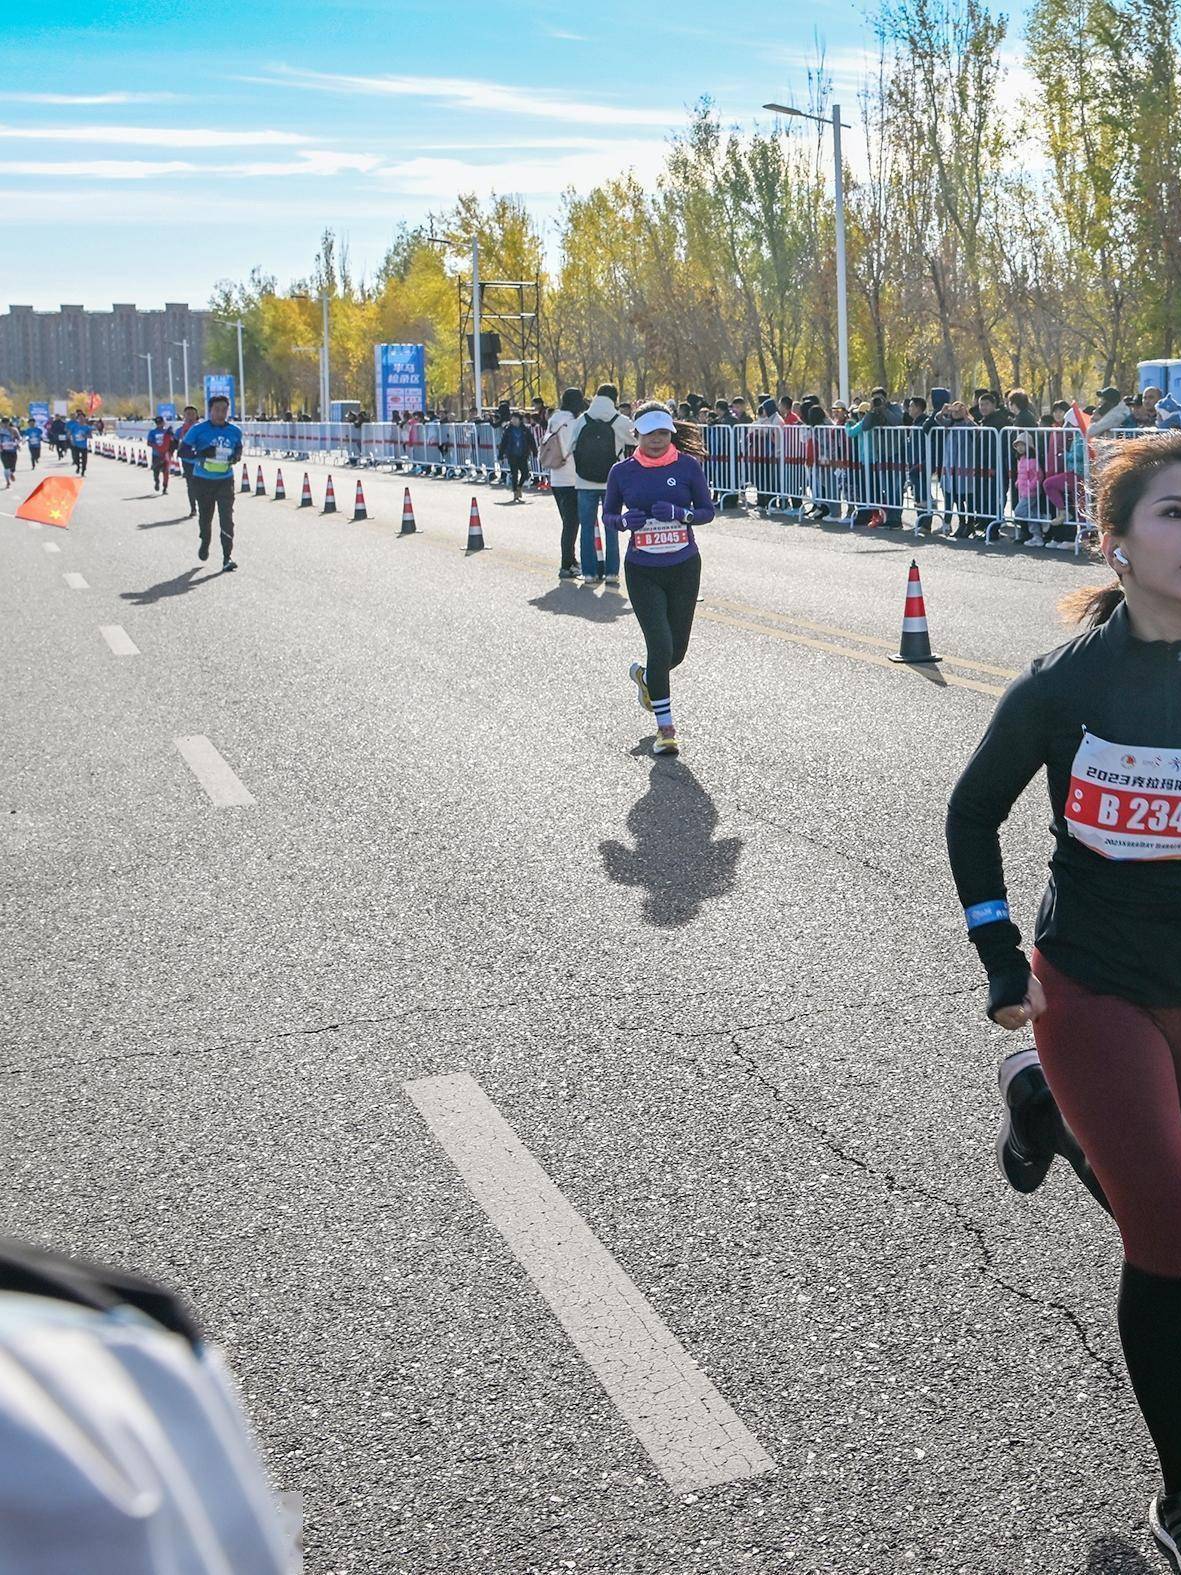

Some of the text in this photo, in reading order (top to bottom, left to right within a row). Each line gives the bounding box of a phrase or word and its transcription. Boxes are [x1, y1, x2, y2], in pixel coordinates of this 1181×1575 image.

[645, 532, 680, 545] B 2045
[1097, 793, 1121, 826] B
